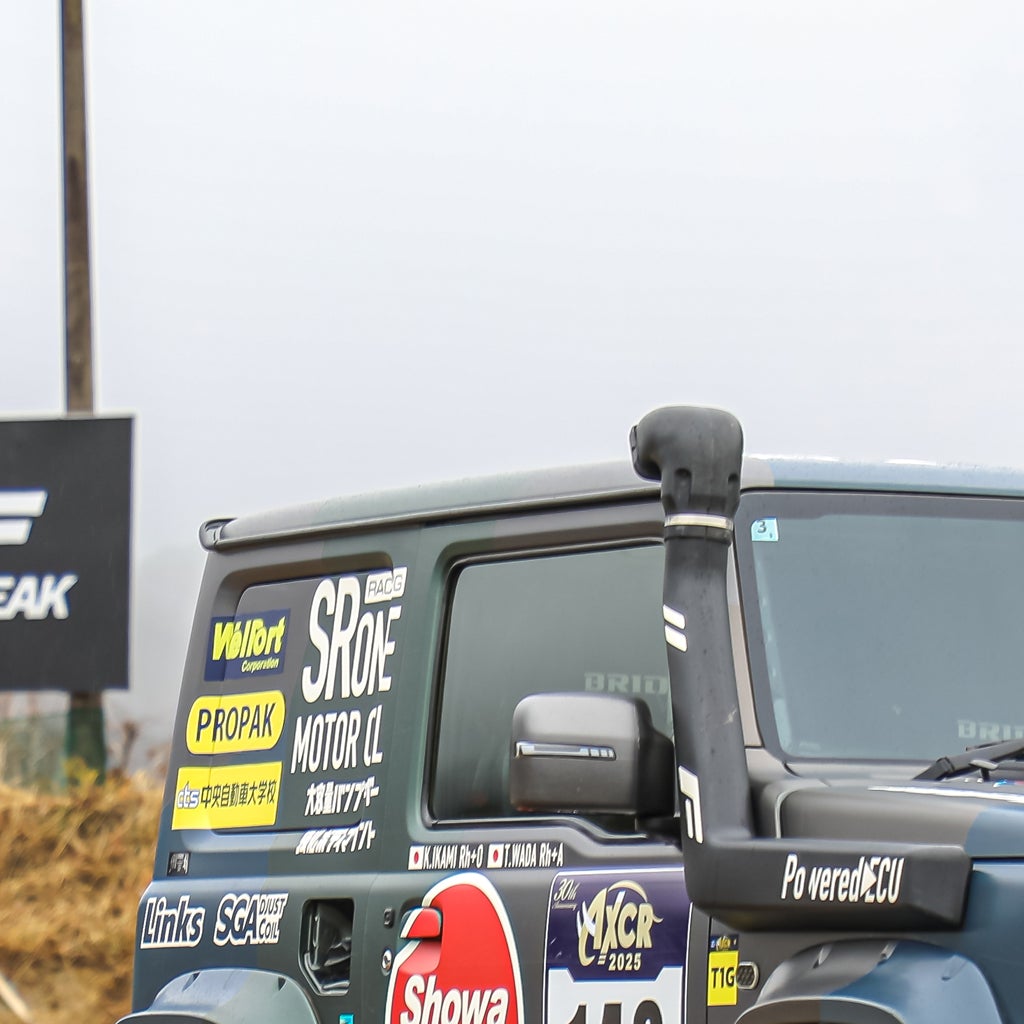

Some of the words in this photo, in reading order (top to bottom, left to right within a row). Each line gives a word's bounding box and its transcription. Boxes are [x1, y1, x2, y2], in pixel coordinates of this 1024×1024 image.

[196, 702, 276, 743] PROPAK
[291, 709, 362, 773] MOTOR
[141, 897, 204, 946] Links
[608, 952, 642, 971] 2025
